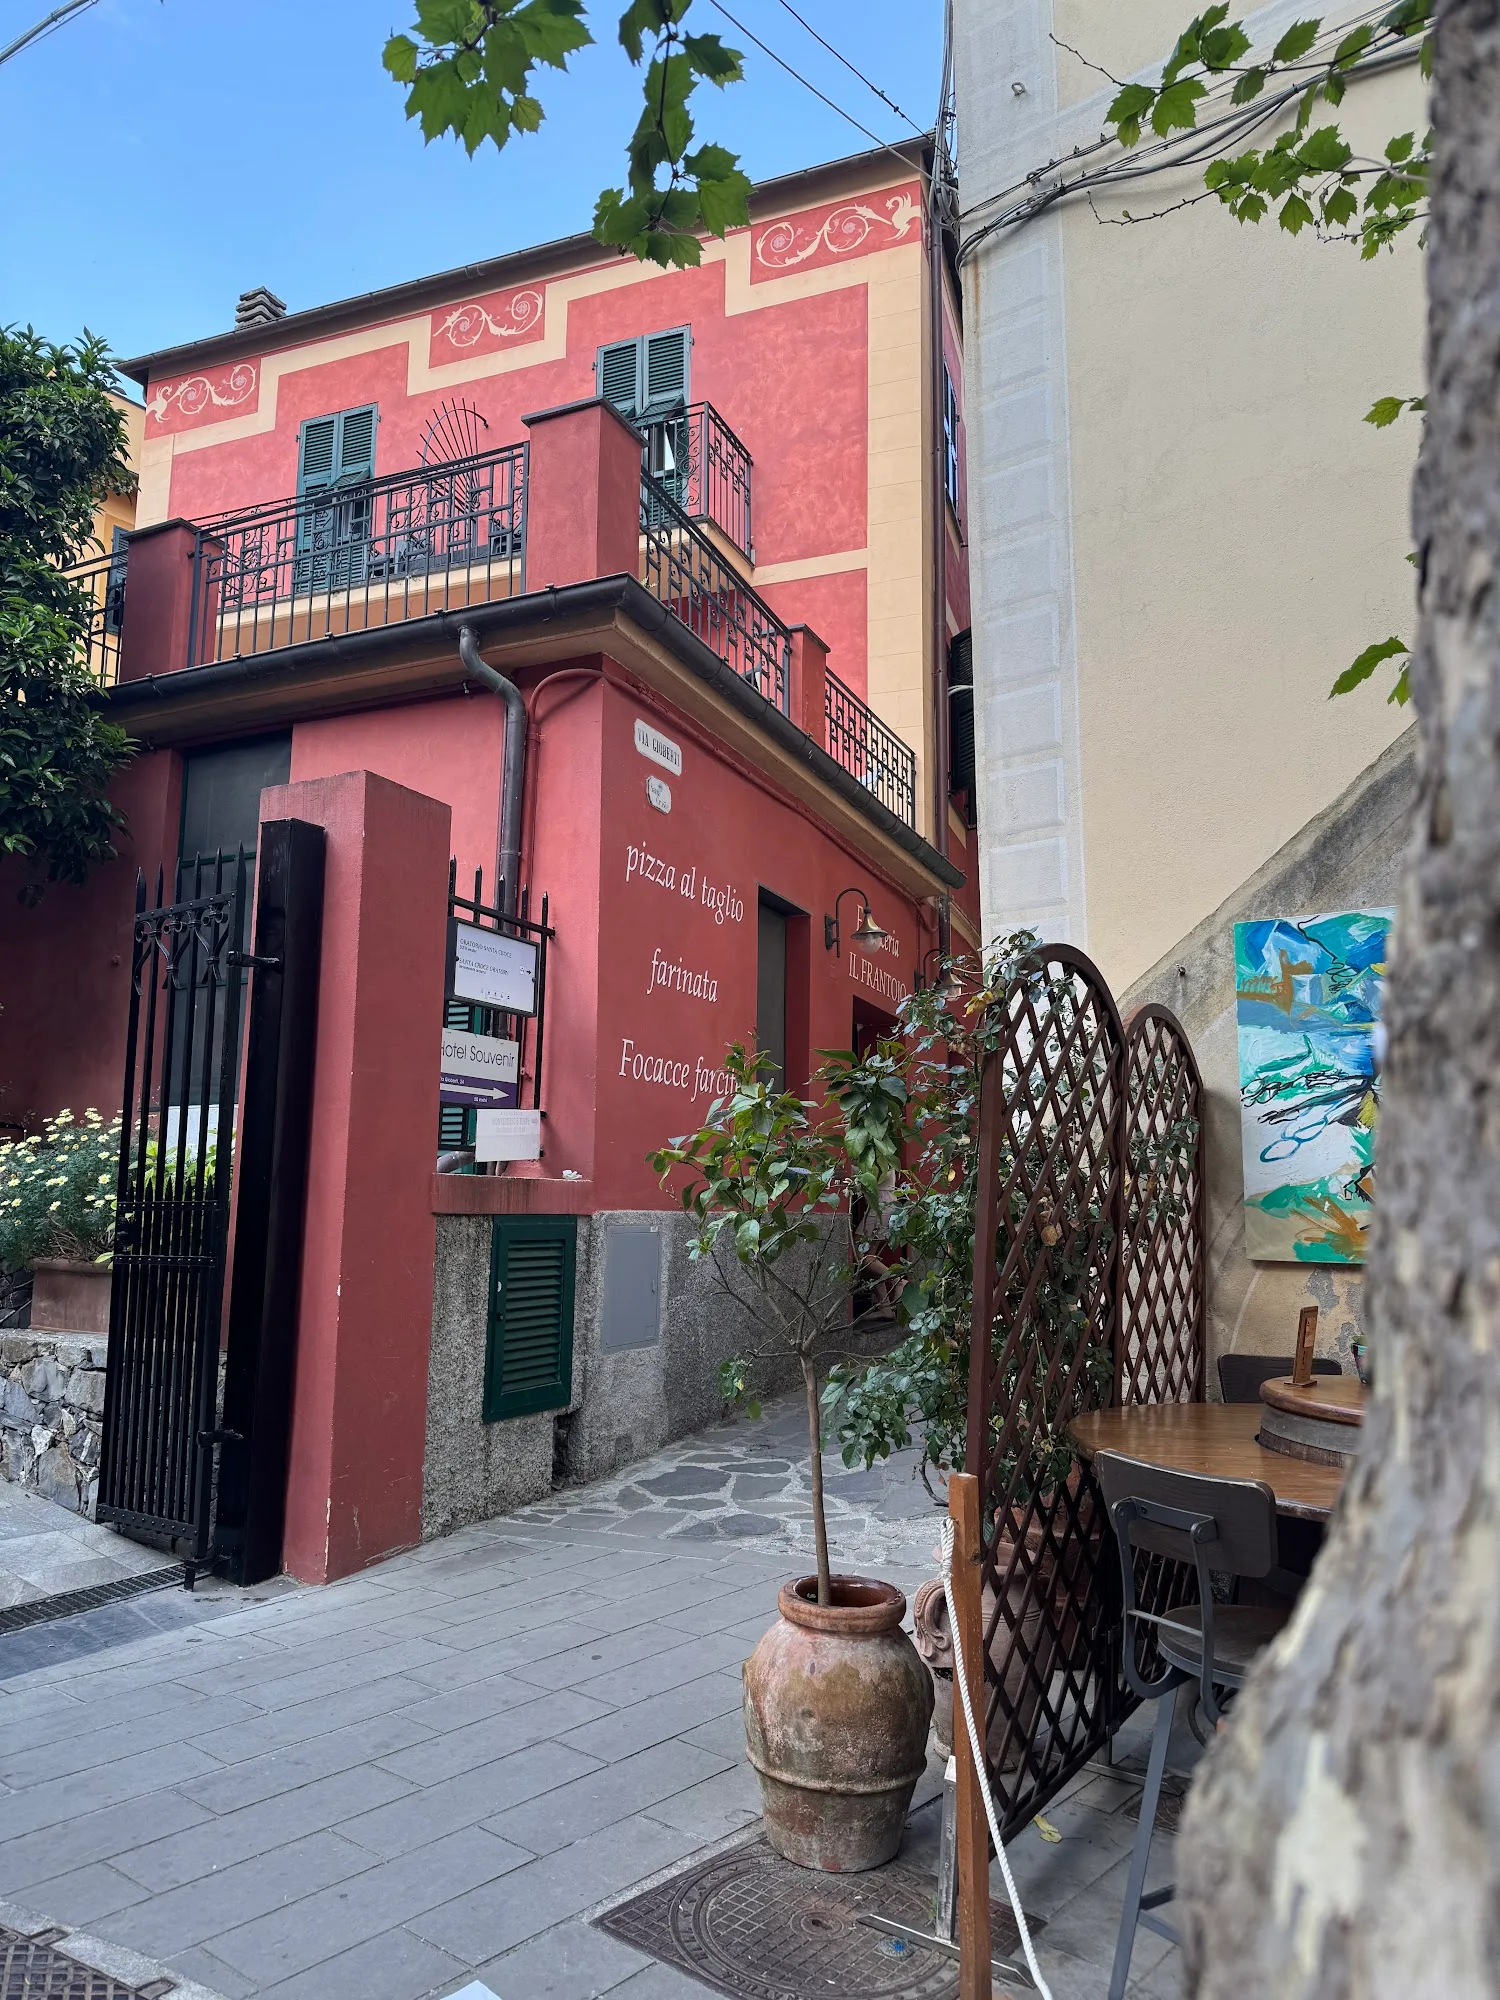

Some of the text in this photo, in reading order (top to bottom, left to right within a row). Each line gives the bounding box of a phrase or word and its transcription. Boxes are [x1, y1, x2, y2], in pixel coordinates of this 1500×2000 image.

[637, 727, 681, 767] VIA GIOBERTI
[626, 841, 744, 924] pizza al taglio
[646, 948, 718, 1002] farinata
[849, 951, 859, 980] IL
[469, 1045, 515, 1068] Souvenir
[618, 1038, 690, 1088] Focacce
